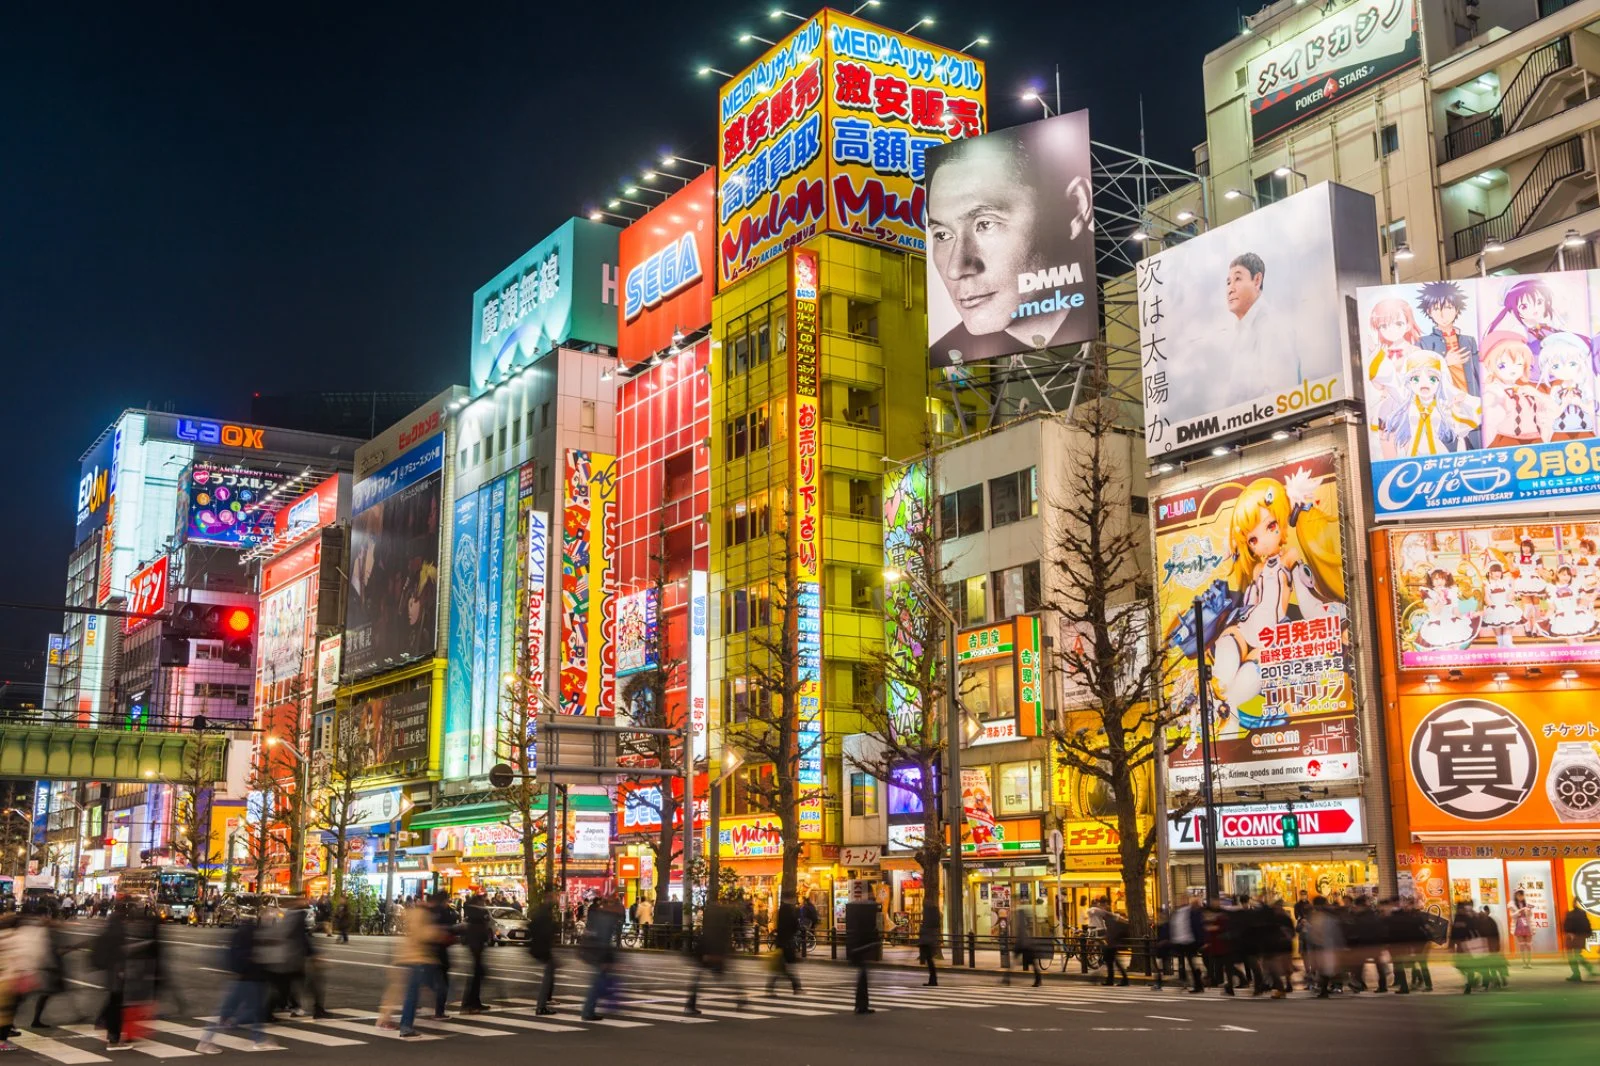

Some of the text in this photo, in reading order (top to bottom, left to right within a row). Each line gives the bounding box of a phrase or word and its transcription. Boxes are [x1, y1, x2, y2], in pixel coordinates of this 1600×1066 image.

[833, 23, 981, 90] MEDIAリサイクル
[721, 19, 821, 123] MEDIAリサイクル
[835, 62, 981, 140] 激安販売
[1295, 88, 1324, 111] POKER
[723, 58, 822, 170] 激安販売
[721, 113, 821, 224] 高額買取
[720, 178, 826, 279] Mulan
[850, 221, 926, 250] ムーラン AKIB
[731, 256, 760, 281] ムーラン
[760, 243, 783, 263] AKIBA
[625, 231, 703, 321] SEGA
[1018, 262, 1084, 293] DMM
[797, 289, 815, 298] あなたの
[1010, 290, 1085, 319] .make
[798, 302, 814, 312] DVD
[797, 323, 815, 333] ゲーム
[800, 334, 812, 342] CD
[797, 343, 815, 353] アイドル
[797, 354, 815, 364] アニメ
[1138, 257, 1172, 454] 次は太陽か。
[798, 365, 815, 374] コミック
[798, 375, 815, 384] ホビー
[1276, 377, 1338, 413] solar
[398, 411, 439, 450] ビックカメラ
[220, 466, 263, 476] AMUSEMENT
[1423, 452, 1509, 472] あにばーさる
[1159, 498, 1196, 520] PLUM
[1426, 491, 1514, 508] 365 DAYS ANNIVERSARY
[531, 514, 545, 571] AKKY
[529, 588, 544, 667] Tax-free
[693, 596, 705, 637] SEGA
[968, 629, 999, 648] 吉野家
[1021, 649, 1033, 703] 吉野家
[1261, 659, 1343, 679] 2019.2 発売予定
[1292, 700, 1346, 713] Eldridge
[1251, 730, 1300, 747] amiami
[1542, 723, 1599, 738] チケット
[1229, 770, 1248, 779] Anime
[1250, 768, 1269, 779] goods
[1272, 767, 1283, 775] and
[1286, 766, 1303, 774] more
[1426, 718, 1528, 806] 質
[37, 787, 48, 816] AKIBA
[624, 787, 677, 826] SEG
[1250, 804, 1268, 812] Support
[801, 811, 819, 820] AKIBA
[733, 820, 781, 850] Mulan
[1224, 838, 1276, 847] Akihabara
[845, 850, 876, 863] ラーメン
[1476, 846, 1493, 856] 時計
[1518, 881, 1544, 889] 大黒屋
